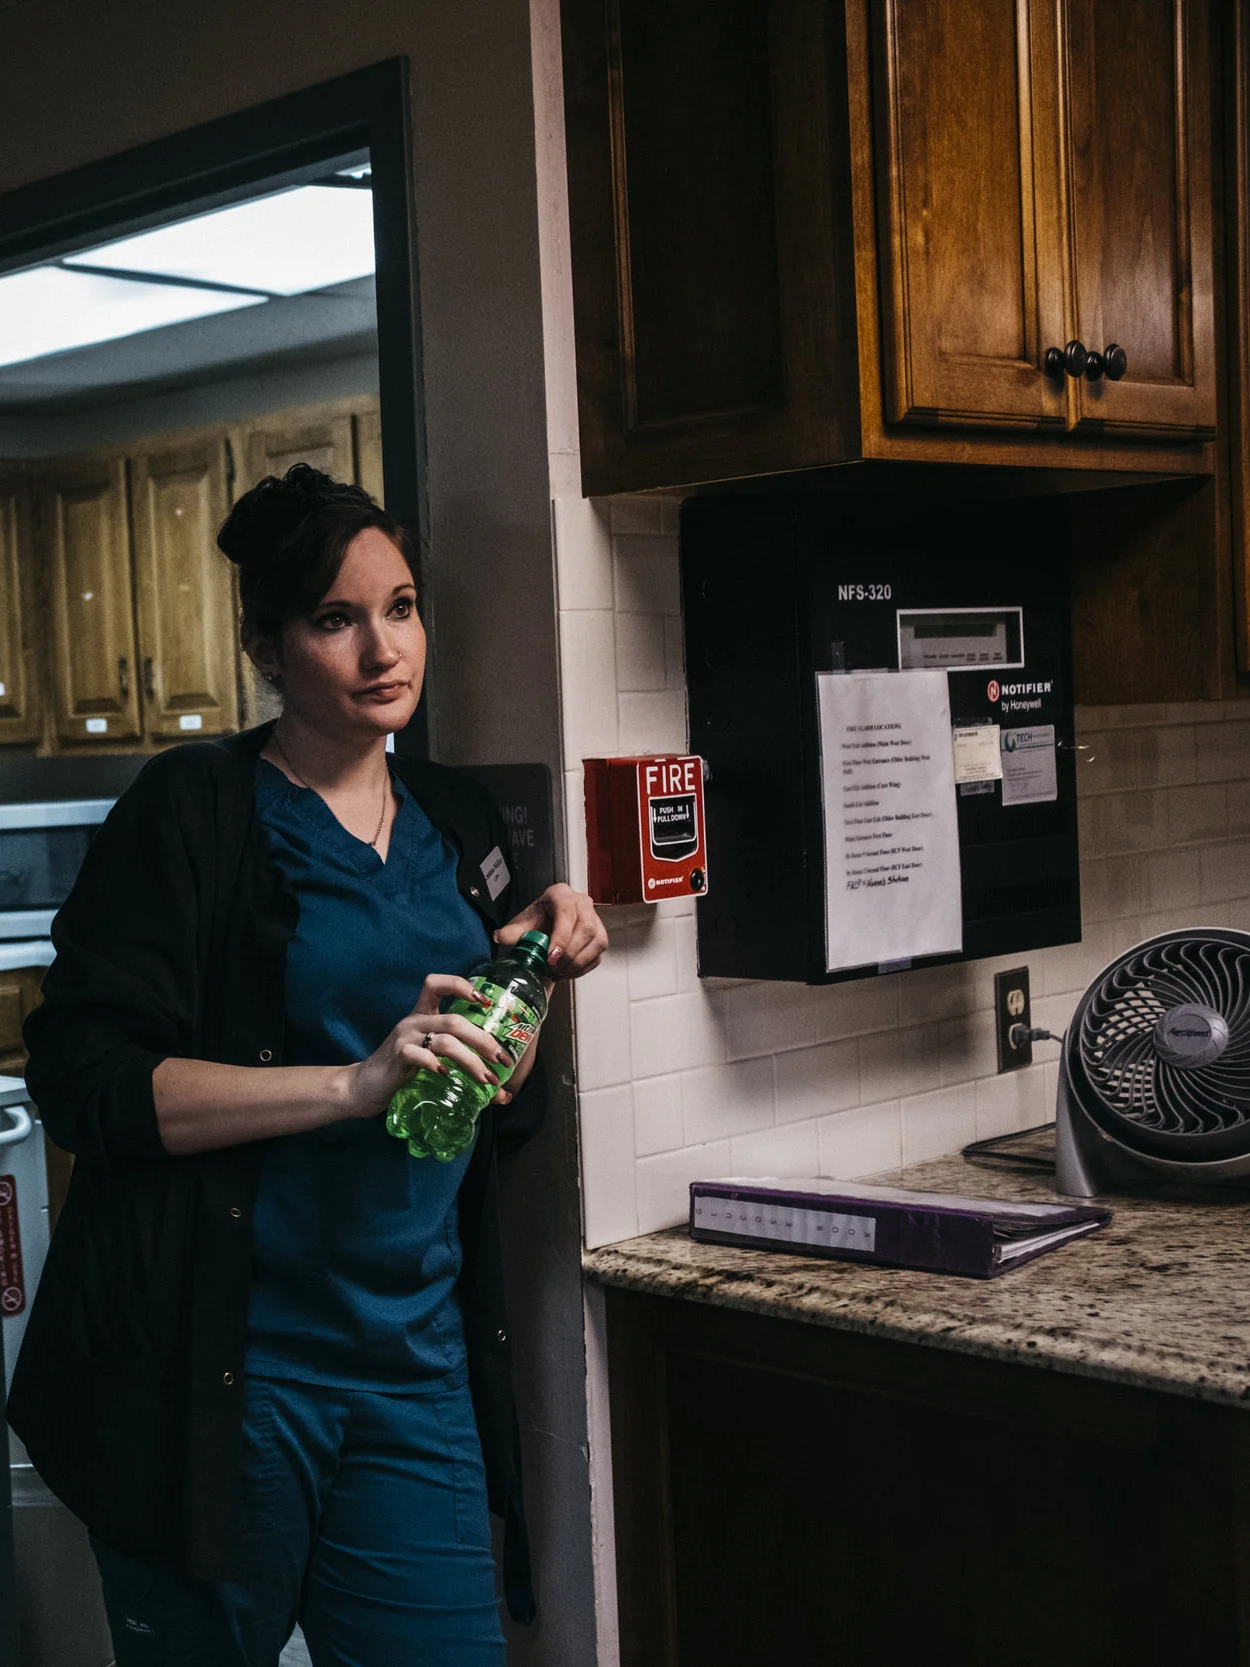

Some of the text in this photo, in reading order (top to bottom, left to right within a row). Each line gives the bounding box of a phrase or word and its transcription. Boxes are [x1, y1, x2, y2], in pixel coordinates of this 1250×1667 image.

[838, 584, 892, 600] NFS-320
[1001, 682, 1051, 695] NOTIFIER
[1001, 698, 1042, 713] by Honeywell
[874, 723, 902, 731] LOCATIONS
[1016, 732, 1033, 743] TECH
[645, 763, 696, 794] FIRE
[499, 803, 527, 824] ING!
[659, 806, 674, 814] PUSH
[657, 813, 687, 823] PULL DOWN
[509, 829, 535, 847] AVE
[655, 878, 683, 886] NOTIFIER
